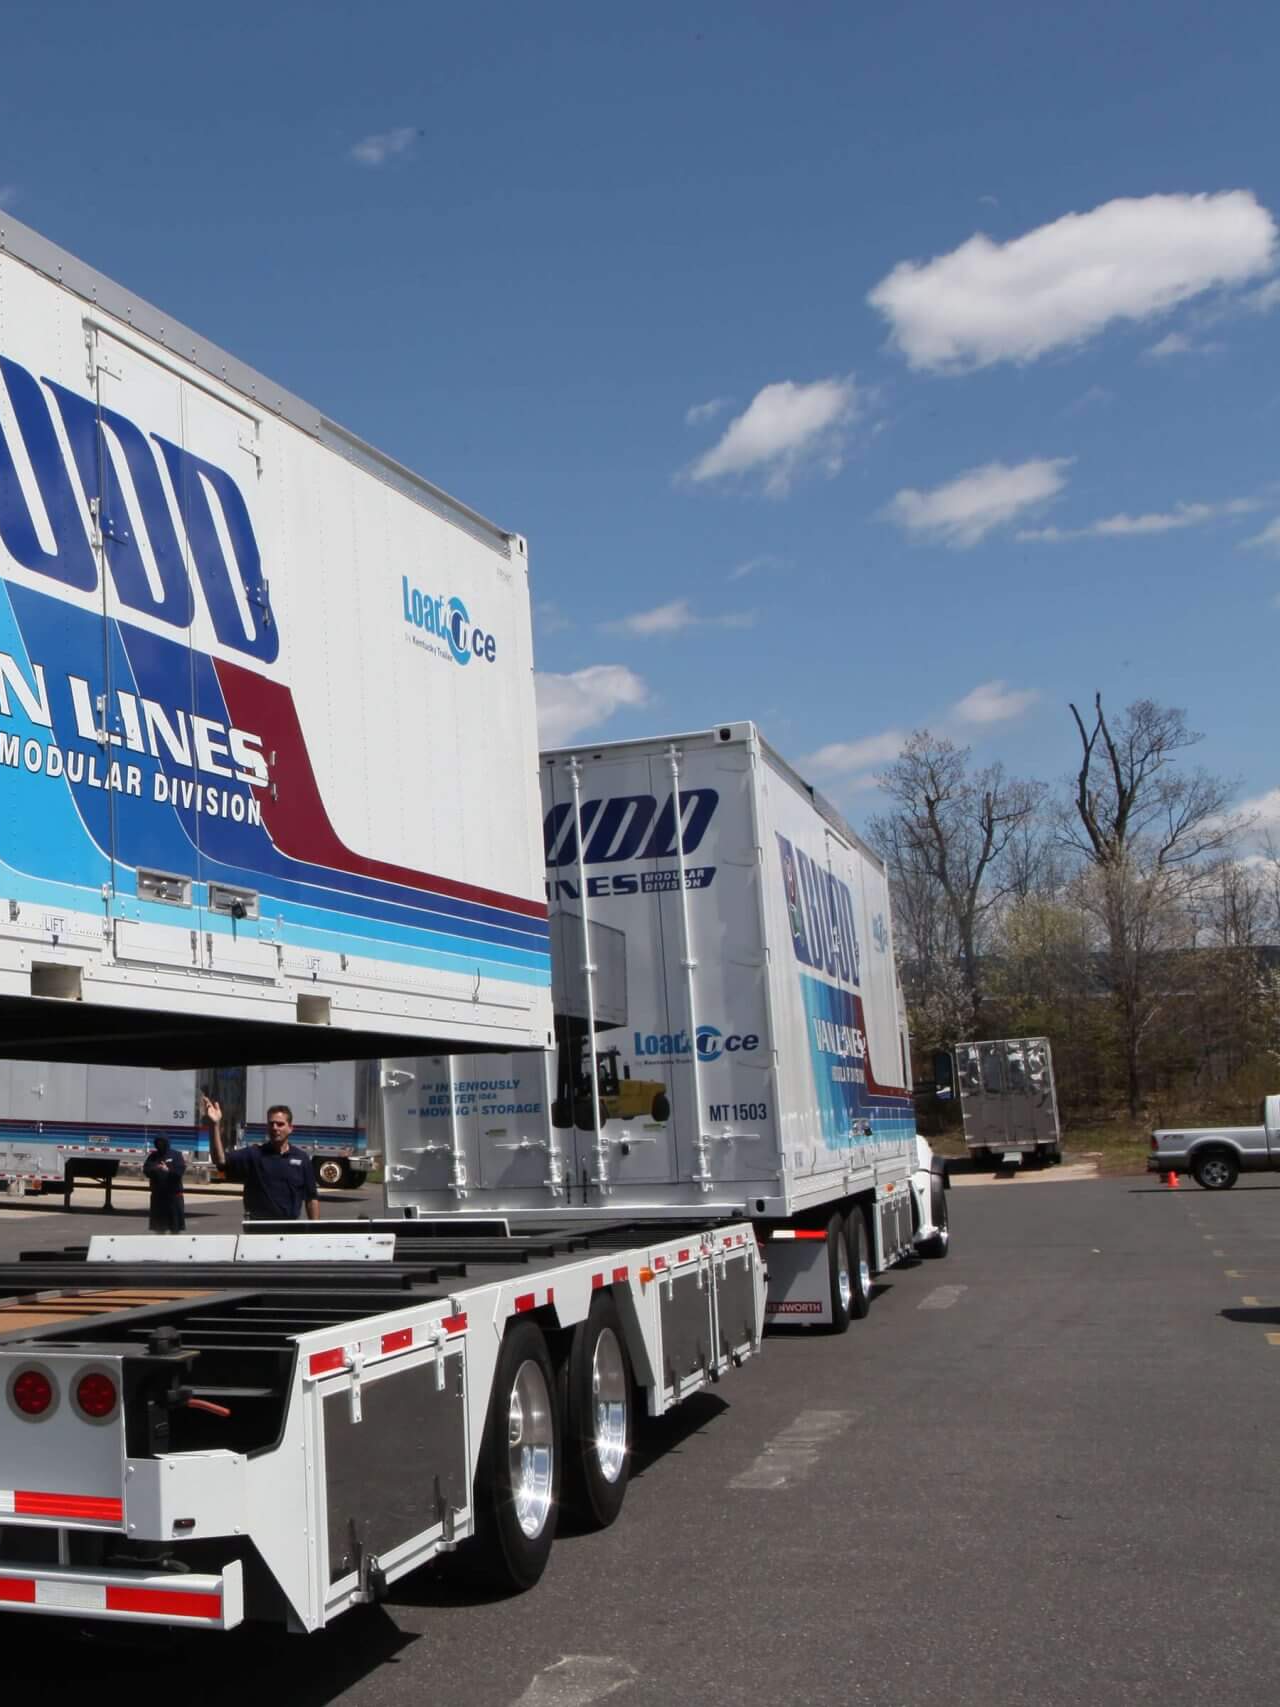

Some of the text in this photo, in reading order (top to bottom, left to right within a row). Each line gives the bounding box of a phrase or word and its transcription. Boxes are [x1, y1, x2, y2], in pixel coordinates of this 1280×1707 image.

[68, 674, 270, 788] LINES
[154, 772, 262, 826] DIVISION
[543, 788, 719, 869] UDD
[644, 879, 701, 892] DIVISON
[481, 1103, 542, 1115] STORAGE
[709, 1103, 767, 1122] MT1503
